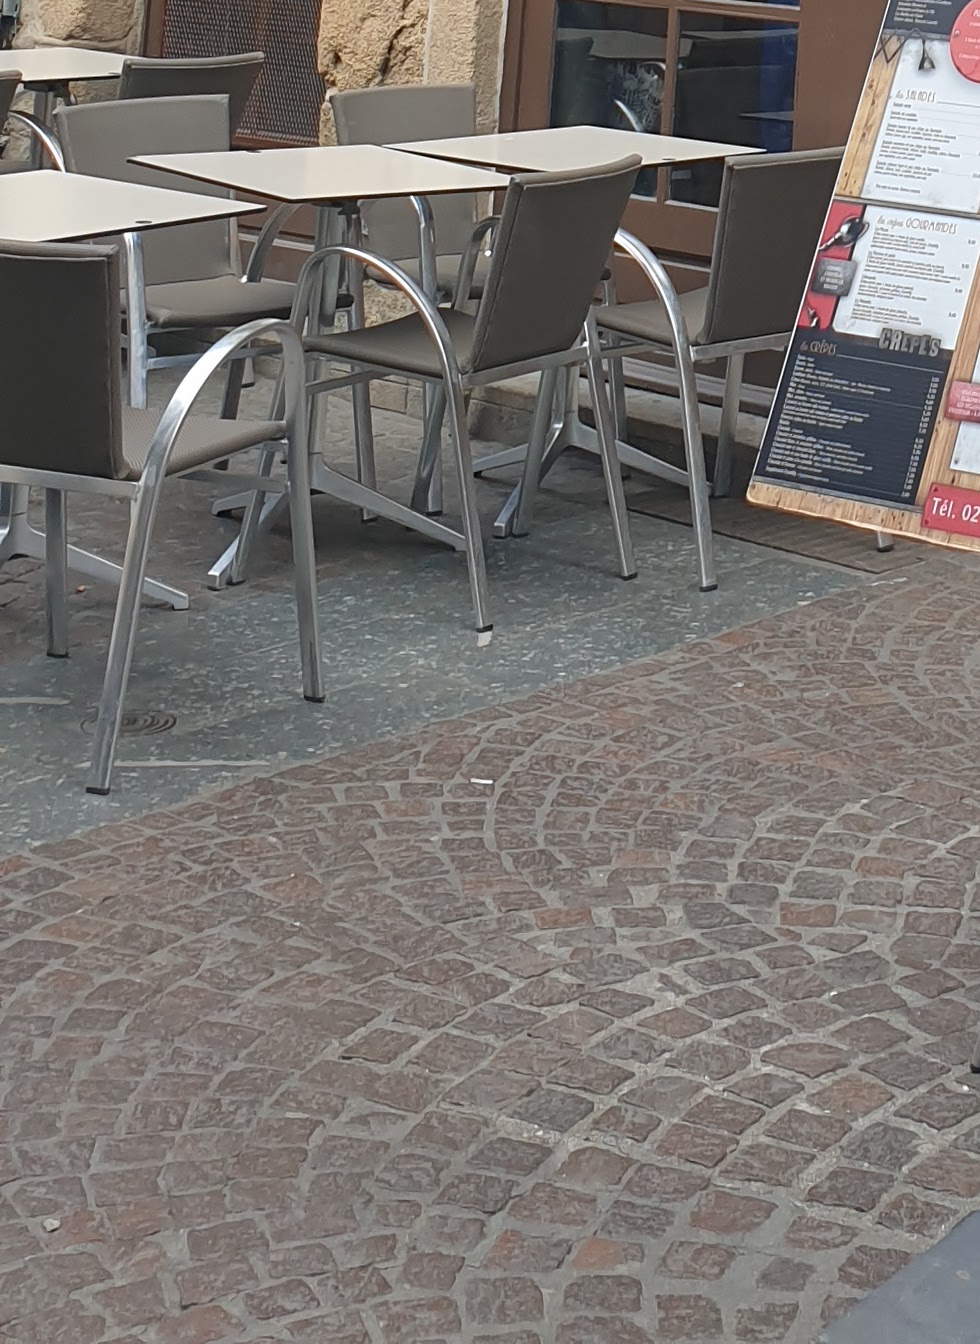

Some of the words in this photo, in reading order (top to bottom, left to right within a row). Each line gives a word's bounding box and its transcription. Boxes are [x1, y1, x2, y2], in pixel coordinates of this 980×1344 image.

[905, 89, 936, 102] SALADES
[904, 217, 958, 234] GOURMANDES
[931, 497, 956, 519] Tél.
[961, 504, 980, 523] 02
